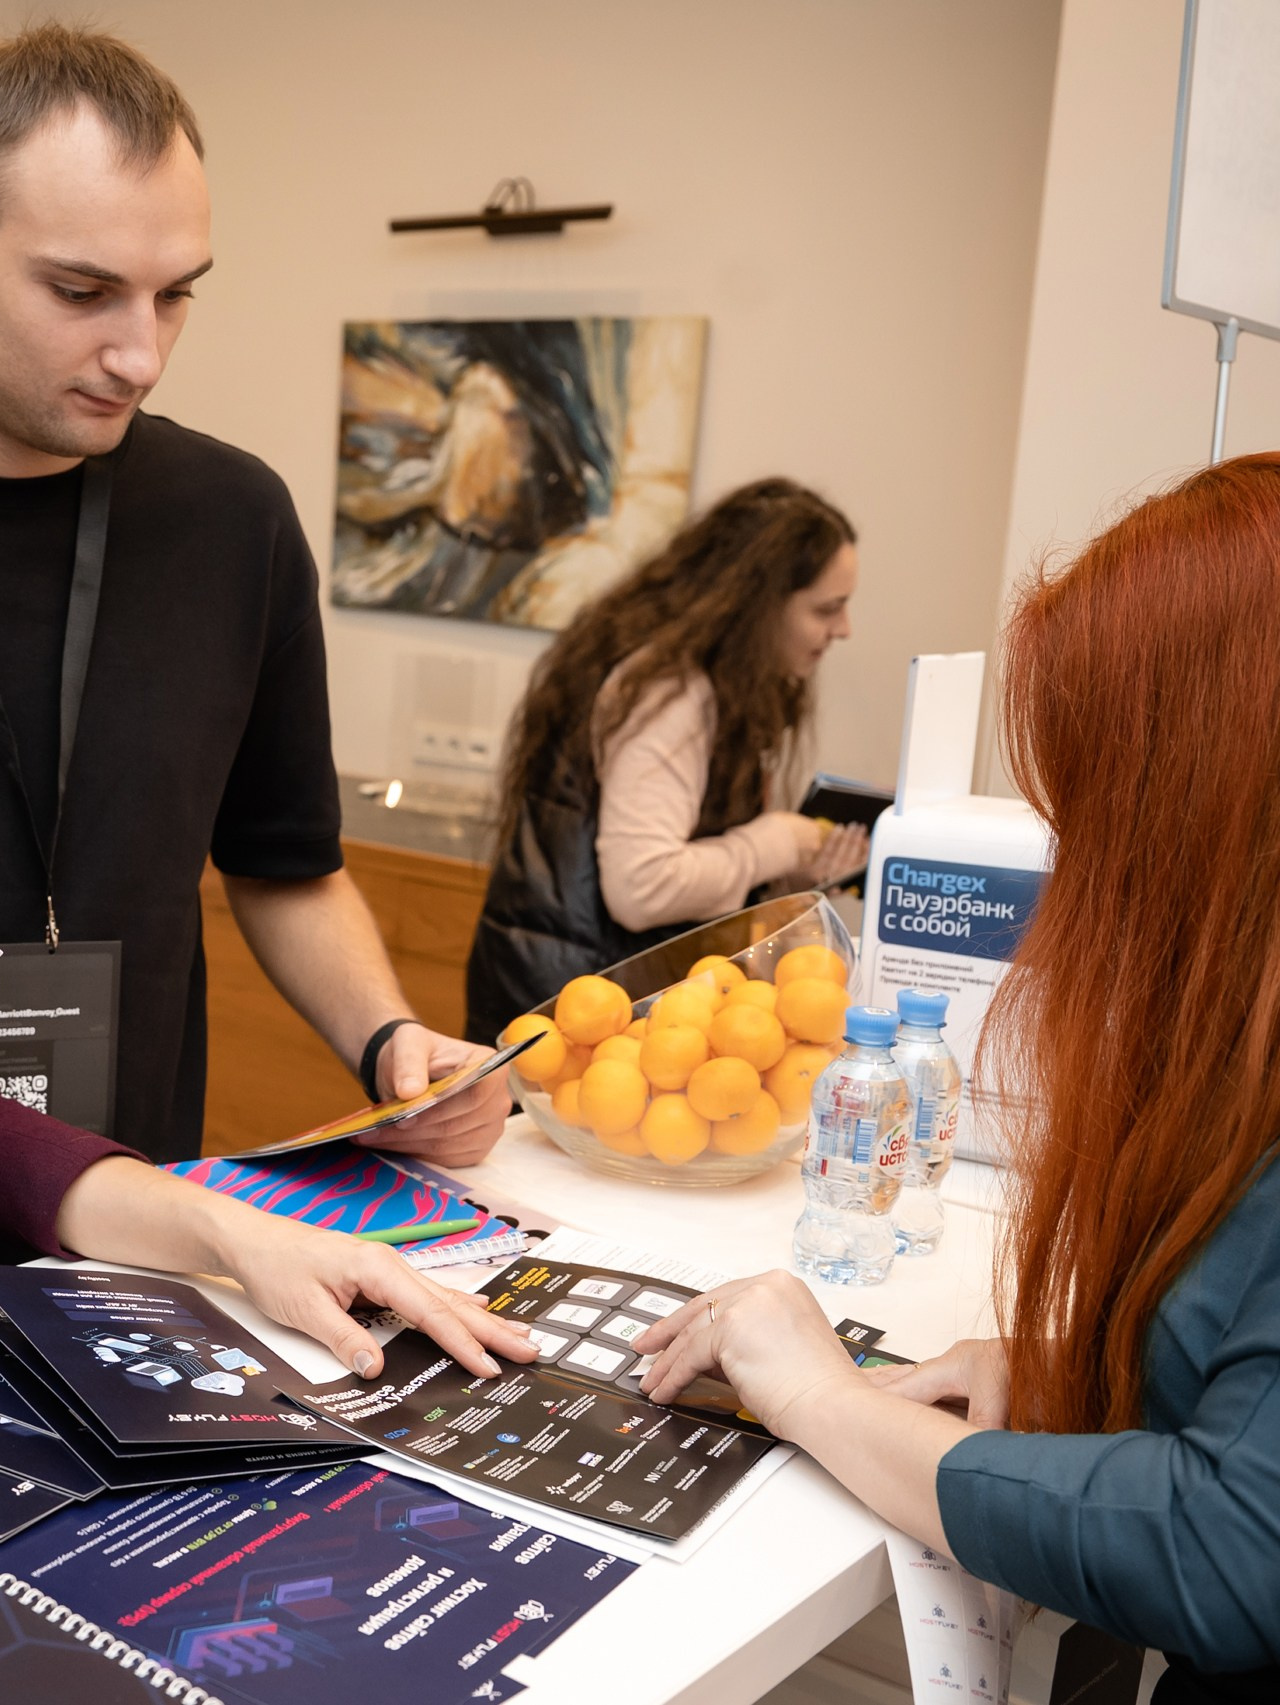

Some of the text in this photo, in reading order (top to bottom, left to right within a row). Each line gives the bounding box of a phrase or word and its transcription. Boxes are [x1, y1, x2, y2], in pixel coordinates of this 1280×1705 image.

[888, 862, 986, 895] Chargex
[886, 885, 1015, 920] Пауэрбанк
[884, 913, 971, 938] с собой
[303, 1389, 365, 1404] Выставка
[324, 1385, 396, 1413] e-commerce
[339, 1400, 398, 1422] решений.
[385, 1358, 454, 1403] Участники:
[615, 1415, 644, 1434] bePaid
[241, 1512, 310, 1554] Виртуальный
[514, 1533, 557, 1565] сайтов
[189, 1551, 245, 1585] облачный
[366, 1554, 426, 1598] доменов
[583, 1553, 618, 1581] FLY.BY
[150, 1582, 192, 1608] сервер
[357, 1566, 455, 1636] и регистрация
[384, 1577, 488, 1651] Хостинг сайтов
